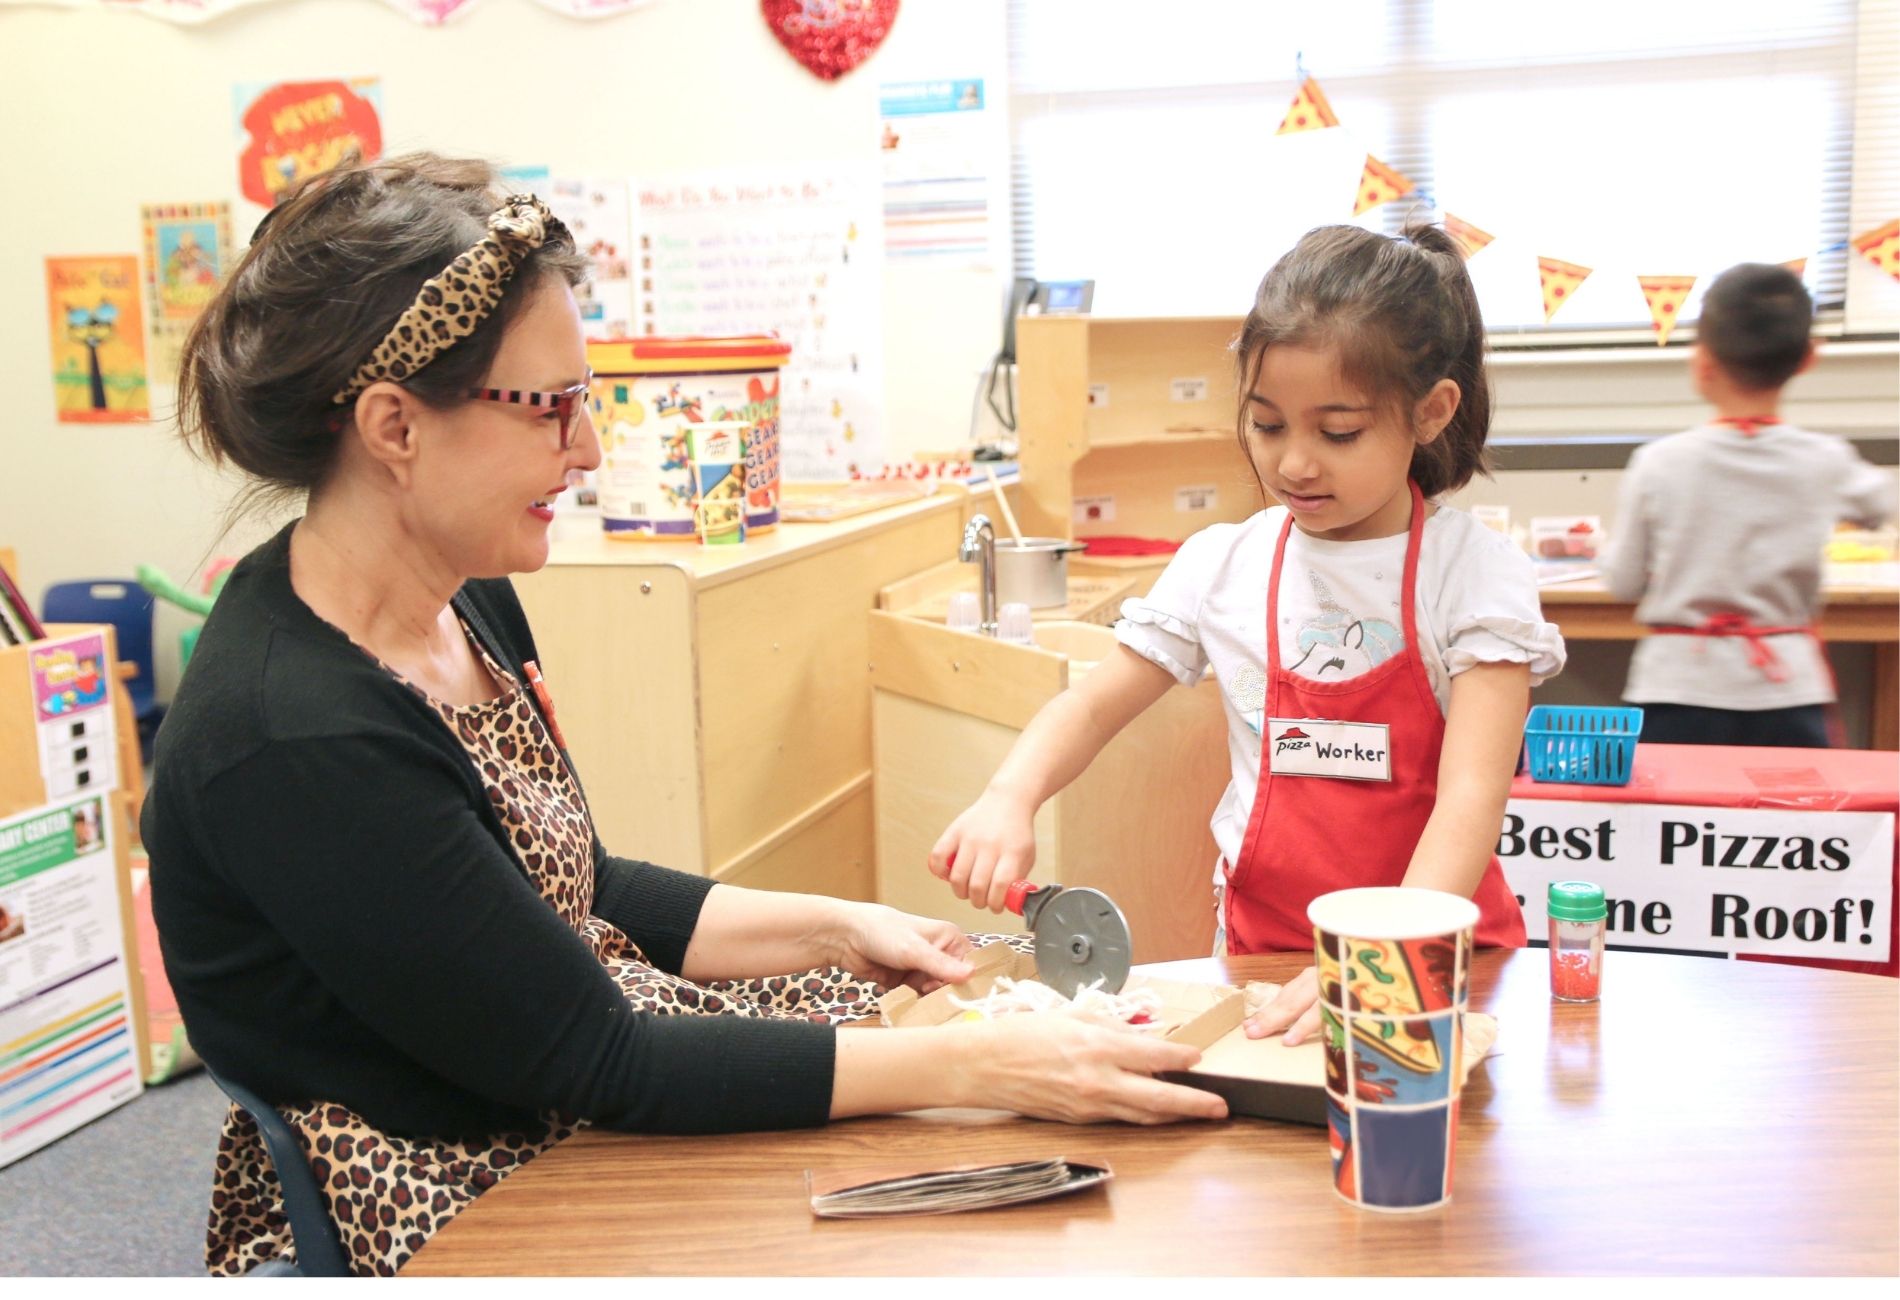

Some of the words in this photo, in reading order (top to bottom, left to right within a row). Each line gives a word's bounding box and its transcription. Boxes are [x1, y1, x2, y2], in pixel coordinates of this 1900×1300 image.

[1275, 738, 1312, 757] pizza
[1315, 741, 1386, 762] Worker
[1495, 813, 1616, 861] Best
[1660, 820, 1851, 872] Pizzas
[1605, 898, 1672, 935] ne
[1710, 893, 1874, 946] Roof!
